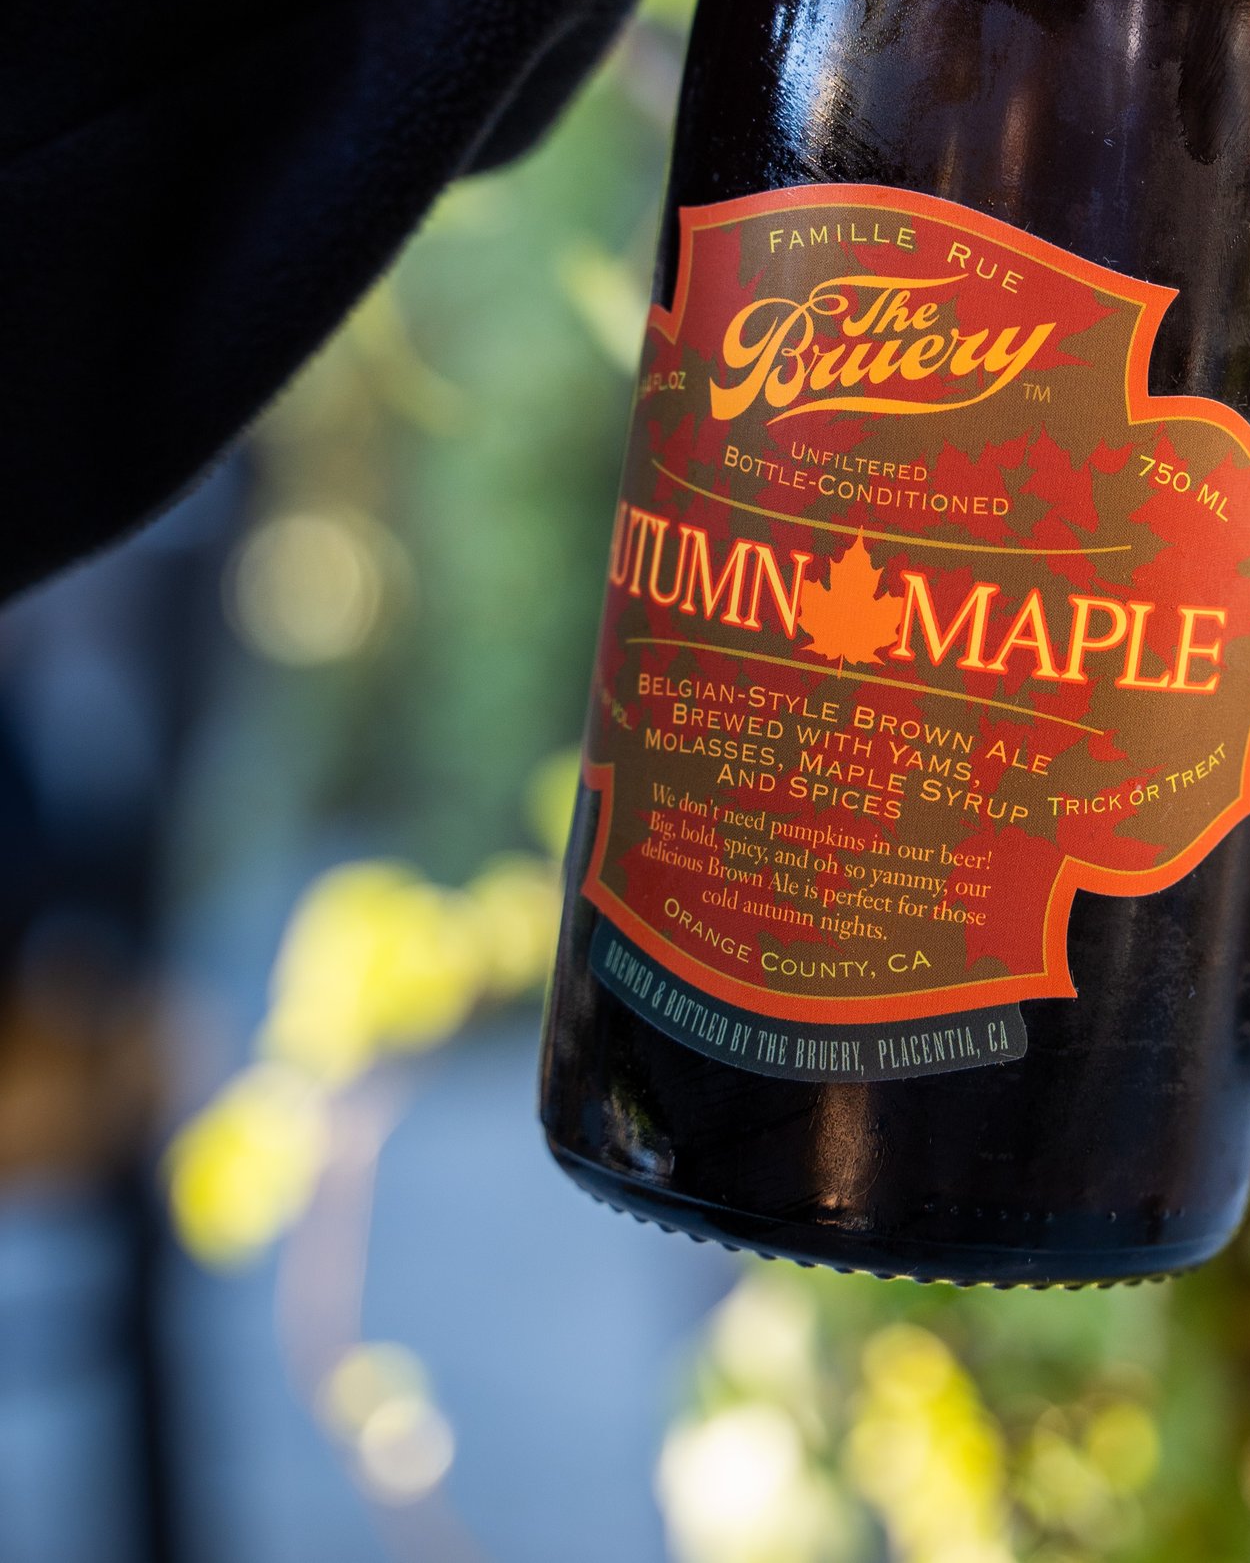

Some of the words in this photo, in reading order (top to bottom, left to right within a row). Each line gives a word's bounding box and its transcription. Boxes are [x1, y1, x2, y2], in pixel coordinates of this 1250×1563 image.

[769, 223, 916, 254] FAMILLE
[947, 241, 1025, 294] RUE
[808, 273, 969, 337] The
[709, 297, 1057, 425] Bruery
[724, 444, 1009, 517] BOTTLE-CONDITIONED
[791, 441, 928, 482] UNFILTERED
[1139, 454, 1193, 495] 750
[1195, 484, 1231, 522] ML
[610, 500, 813, 640] UTUMN
[892, 570, 1228, 695] MAPLE
[638, 672, 840, 724] BELGIAN-STYLE
[854, 705, 974, 754] BROWN
[985, 739, 1052, 776] ALE
[672, 702, 784, 740] BREWED
[796, 724, 873, 758] WITH
[889, 740, 981, 789] YAMS,
[645, 728, 784, 772] MOLASSES,
[799, 750, 907, 795] MAPLE
[919, 779, 1029, 824] SYRUP
[716, 763, 776, 793] AND
[788, 776, 902, 820] SPICES
[1048, 793, 1123, 816] TRICK
[1129, 783, 1160, 807] OR
[1165, 742, 1227, 793] TREAT
[649, 810, 677, 841] Big,
[681, 819, 718, 853] bold,
[723, 836, 769, 866] spicy,
[774, 849, 809, 869] and
[813, 853, 839, 875] oh
[843, 863, 866, 880] so
[869, 867, 948, 898] yammy,
[955, 880, 992, 899] our
[653, 782, 676, 808] We
[679, 792, 720, 821] don't
[723, 810, 766, 832] need
[770, 819, 866, 851] pumpkins
[871, 833, 891, 856] in
[897, 844, 935, 863] our
[940, 844, 993, 870] beer!
[641, 836, 704, 873] delicious
[707, 855, 764, 888] Brown
[768, 870, 799, 896] Ale
[804, 877, 818, 900] is
[823, 887, 893, 914] perfect
[897, 894, 929, 918] for
[932, 900, 987, 926] those
[702, 887, 739, 911] cold
[742, 899, 815, 928] autumn
[820, 912, 887, 941] nights.
[664, 897, 753, 964] ORANGE
[760, 951, 876, 979] COUNTY,
[887, 950, 932, 973] CA
[604, 938, 655, 1001] BREWED
[652, 979, 667, 1009] &
[664, 988, 729, 1047] BOTTLED
[729, 1021, 753, 1056] BY
[756, 1029, 789, 1066] THE
[794, 1037, 865, 1076] BRUERY,
[878, 1025, 982, 1070] PLACENTIA,
[987, 1020, 1009, 1053] CA
